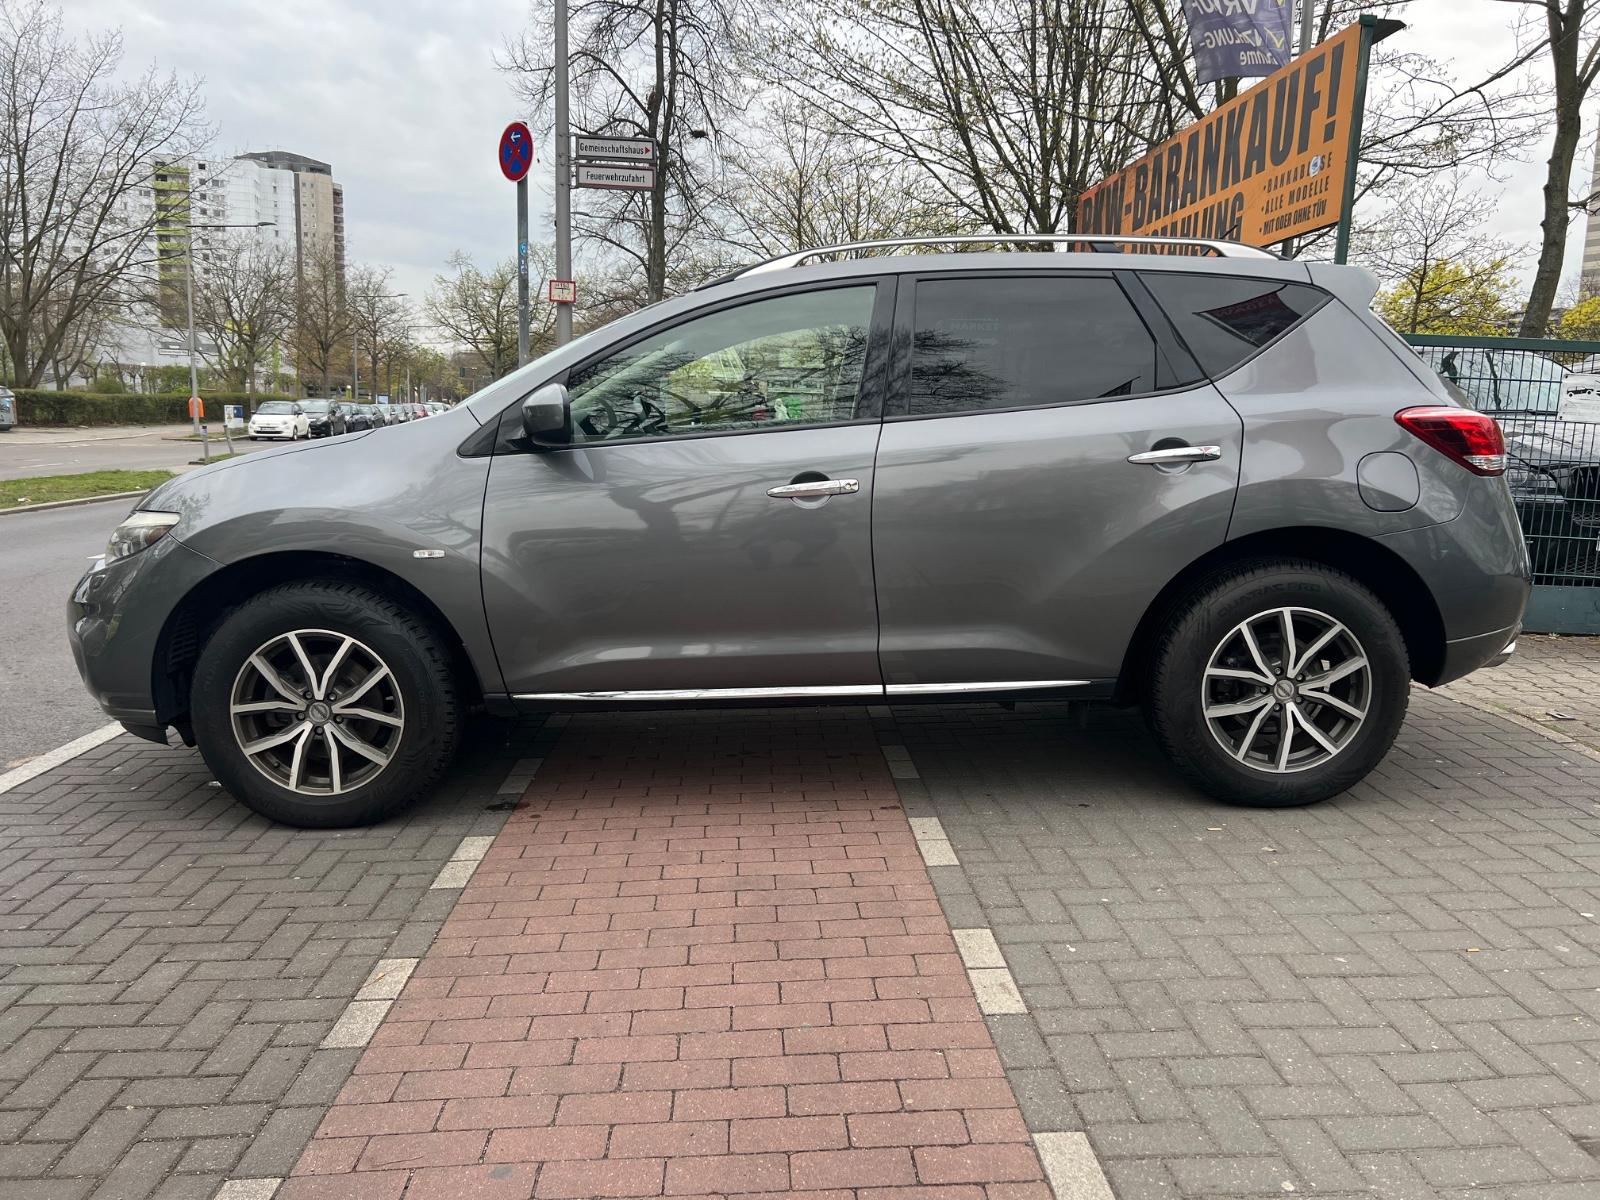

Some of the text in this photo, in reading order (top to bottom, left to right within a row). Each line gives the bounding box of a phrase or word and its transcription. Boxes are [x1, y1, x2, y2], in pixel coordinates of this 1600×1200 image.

[580, 143, 644, 155] Gemeinschaftshaus
[586, 170, 645, 183] Feuerwehrzufahrt
[1265, 176, 1330, 215] ALLE MODELLE
[1263, 199, 1327, 236] MIT ODER OHNE TÜV
